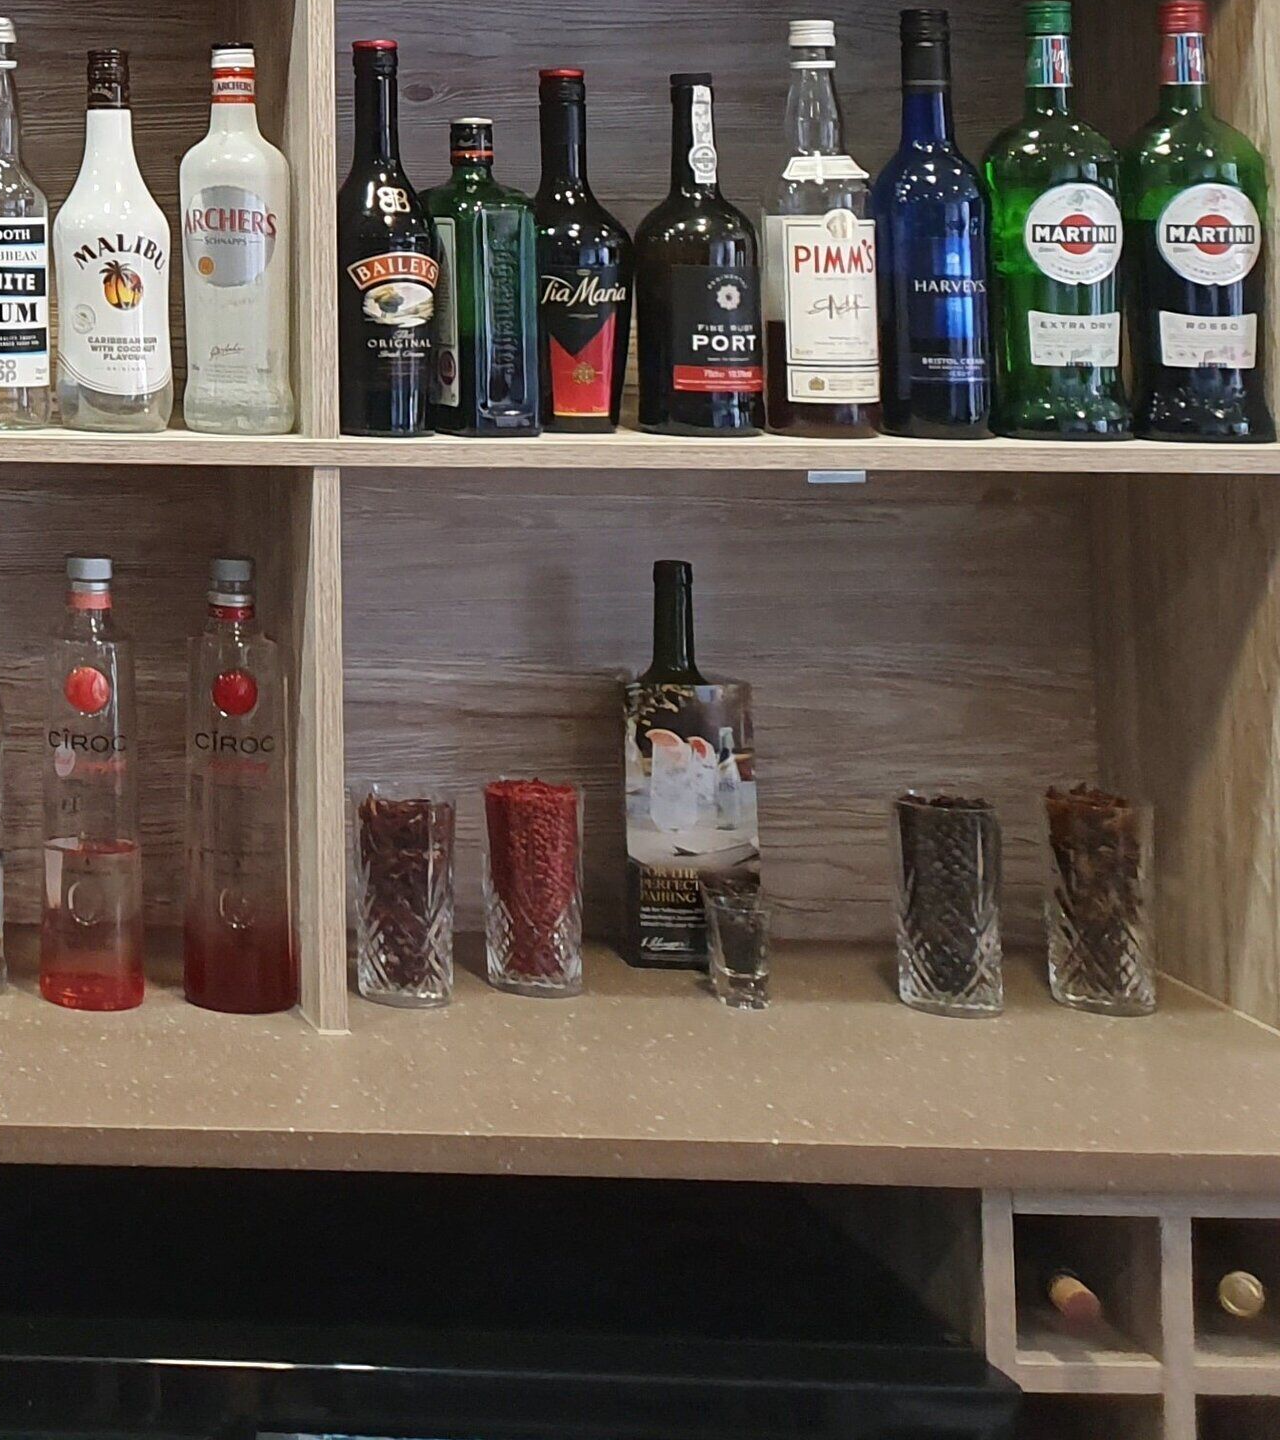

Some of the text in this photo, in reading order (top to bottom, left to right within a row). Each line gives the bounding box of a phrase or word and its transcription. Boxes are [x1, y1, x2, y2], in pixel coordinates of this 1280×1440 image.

[185, 207, 277, 237] ARCHERS
[1034, 224, 1117, 243] MARTINI
[1167, 225, 1255, 243] MARTINI
[72, 233, 166, 273] MALIBU
[794, 239, 876, 274] PIMM'S
[356, 255, 438, 282] BAILEYS
[540, 274, 627, 307] Tia Maria
[914, 279, 987, 294] HARVEYS
[697, 323, 724, 333] FINE
[1039, 319, 1113, 332] EXTRA DRY
[1185, 321, 1240, 332] ROSSO
[87, 335, 140, 345] CARIBBEAN
[90, 344, 114, 353] WITH
[366, 339, 432, 349] ORIGINAL
[692, 334, 758, 352] PORT
[47, 728, 128, 754] CÎROC
[194, 731, 276, 756] CÎROC
